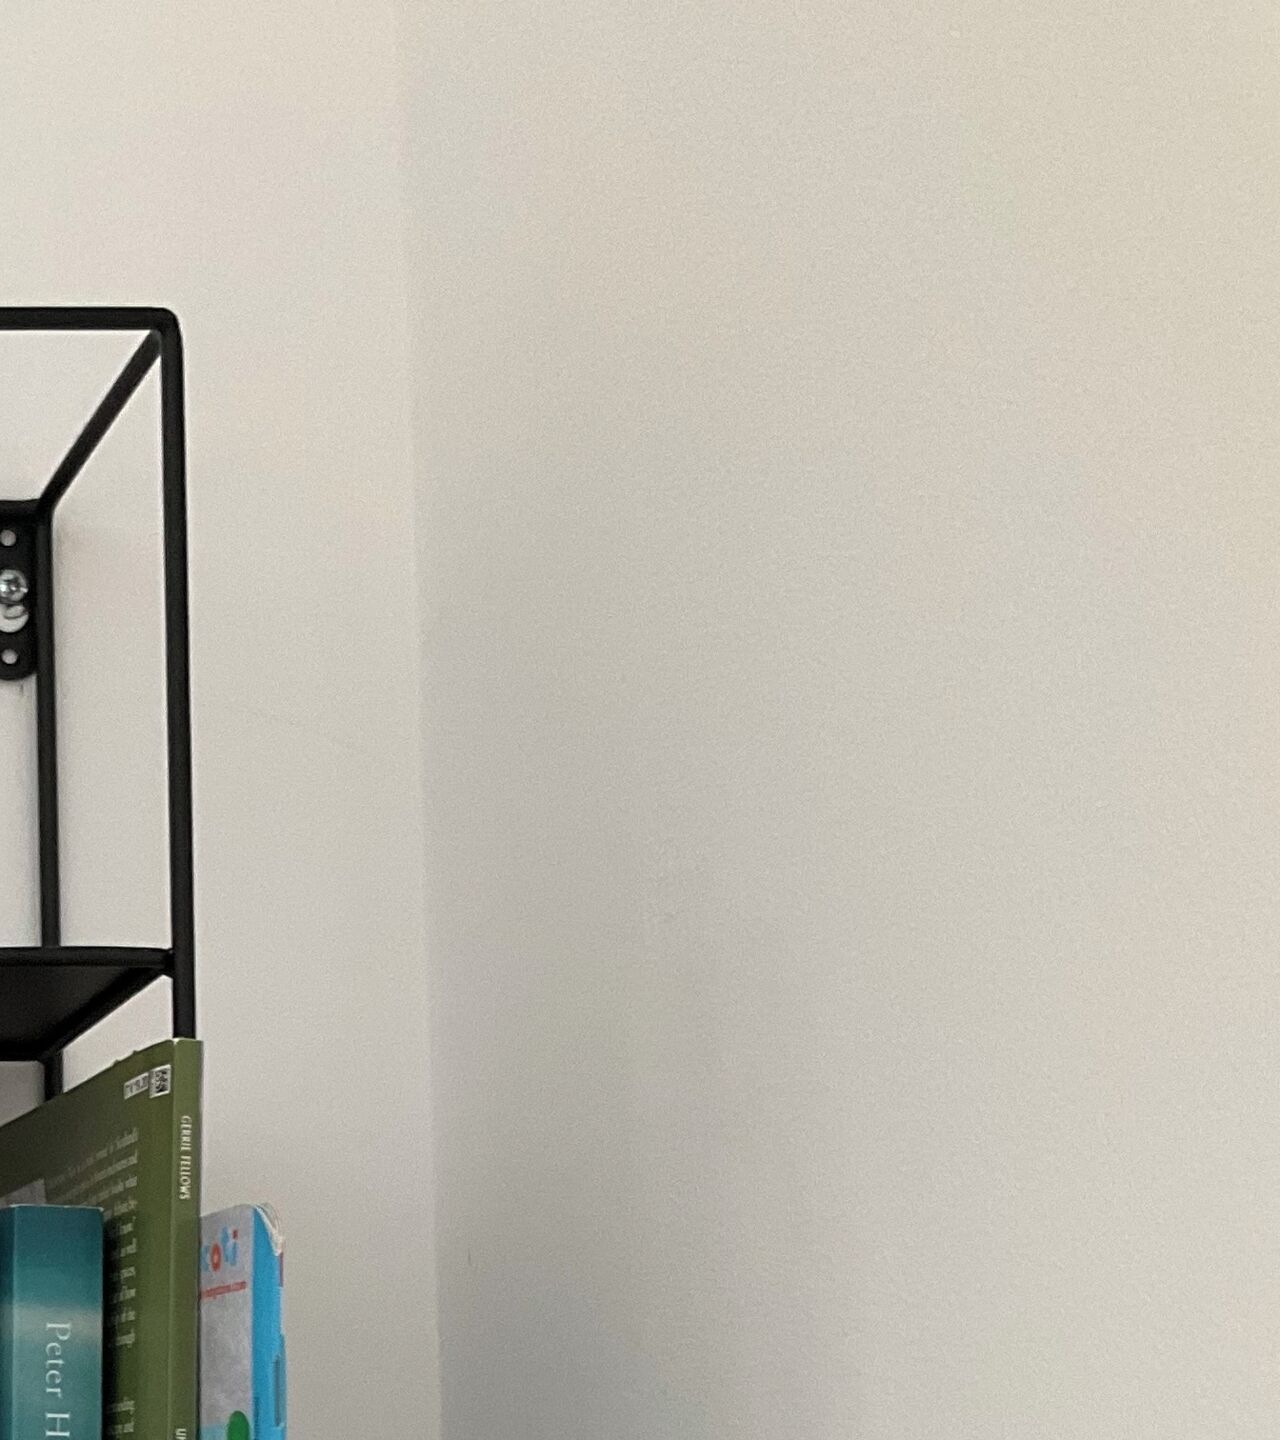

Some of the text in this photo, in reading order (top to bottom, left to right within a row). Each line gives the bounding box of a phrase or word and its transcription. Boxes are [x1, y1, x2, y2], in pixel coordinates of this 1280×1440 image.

[179, 1115, 192, 1200] GERRIE FELLOWS
[44, 1321, 73, 1399] Peter
